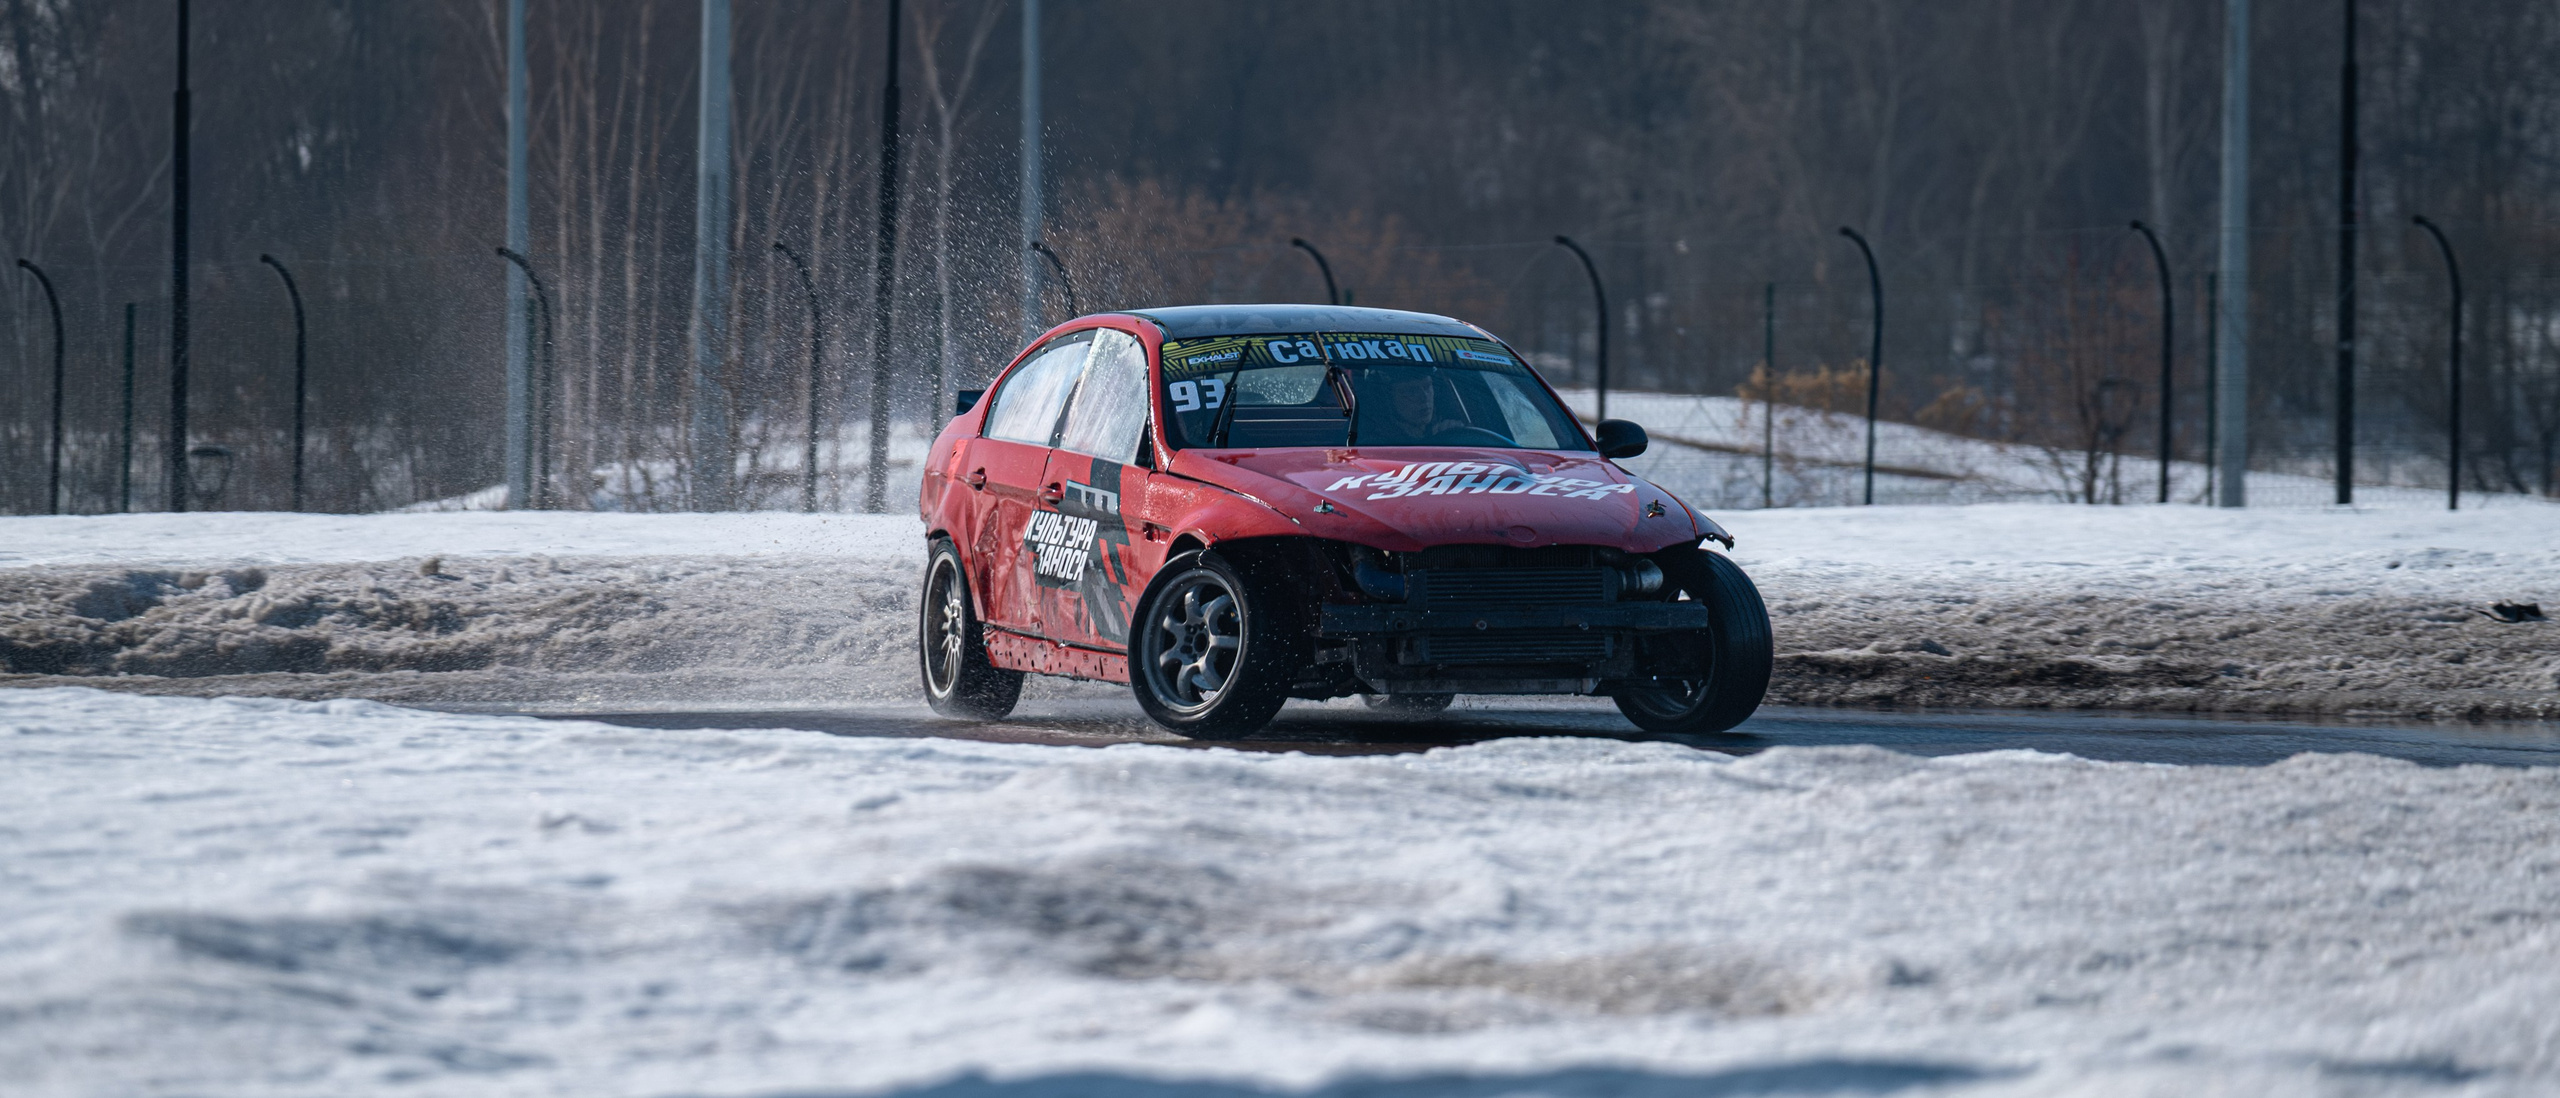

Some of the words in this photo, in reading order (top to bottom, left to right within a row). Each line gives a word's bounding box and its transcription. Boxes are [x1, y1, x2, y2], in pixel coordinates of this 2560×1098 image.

[1189, 351, 1240, 365] EXHAUST
[1169, 379, 1226, 412] 93
[1325, 462, 1637, 495] КУЛЬТУРА
[1367, 474, 1615, 501] ЗАНОСА
[1023, 510, 1098, 551] КУЛЬТУРА
[1035, 543, 1089, 581] ЗАНОСА
